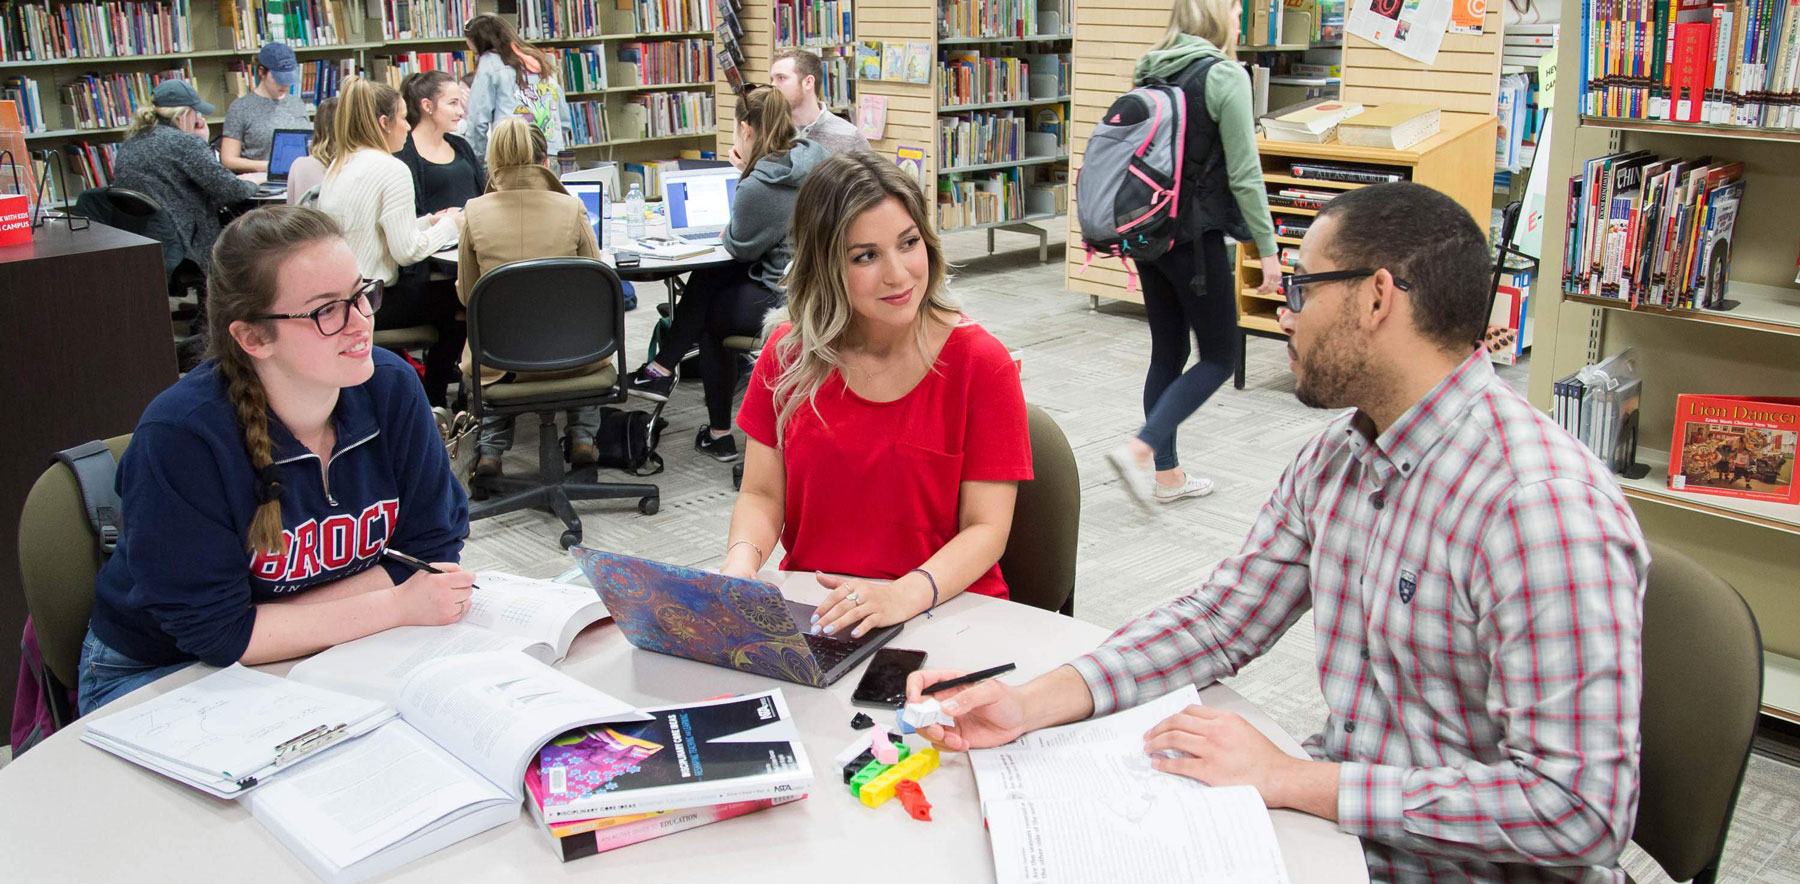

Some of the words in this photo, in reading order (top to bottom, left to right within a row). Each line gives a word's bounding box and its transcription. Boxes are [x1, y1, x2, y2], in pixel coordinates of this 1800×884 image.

[1316, 172, 1345, 180] ATLAS
[1617, 166, 1641, 189] CHIN
[1601, 170, 1609, 200] EYEWITNESS
[1292, 200, 1321, 208] ATLAS
[4, 214, 17, 222] WITH
[18, 212, 28, 220] KIDS
[2, 221, 29, 231] CAMPUS
[1690, 402, 1727, 418] Lion
[1733, 406, 1797, 424] Dancer
[668, 714, 678, 729] IDEAS
[671, 729, 682, 743] CORE
[674, 743, 691, 778] DISCIPLINARY
[774, 784, 792, 792] NSTA
[557, 808, 598, 816] DISCIPLINARY
[660, 812, 698, 828] EDUCATION
